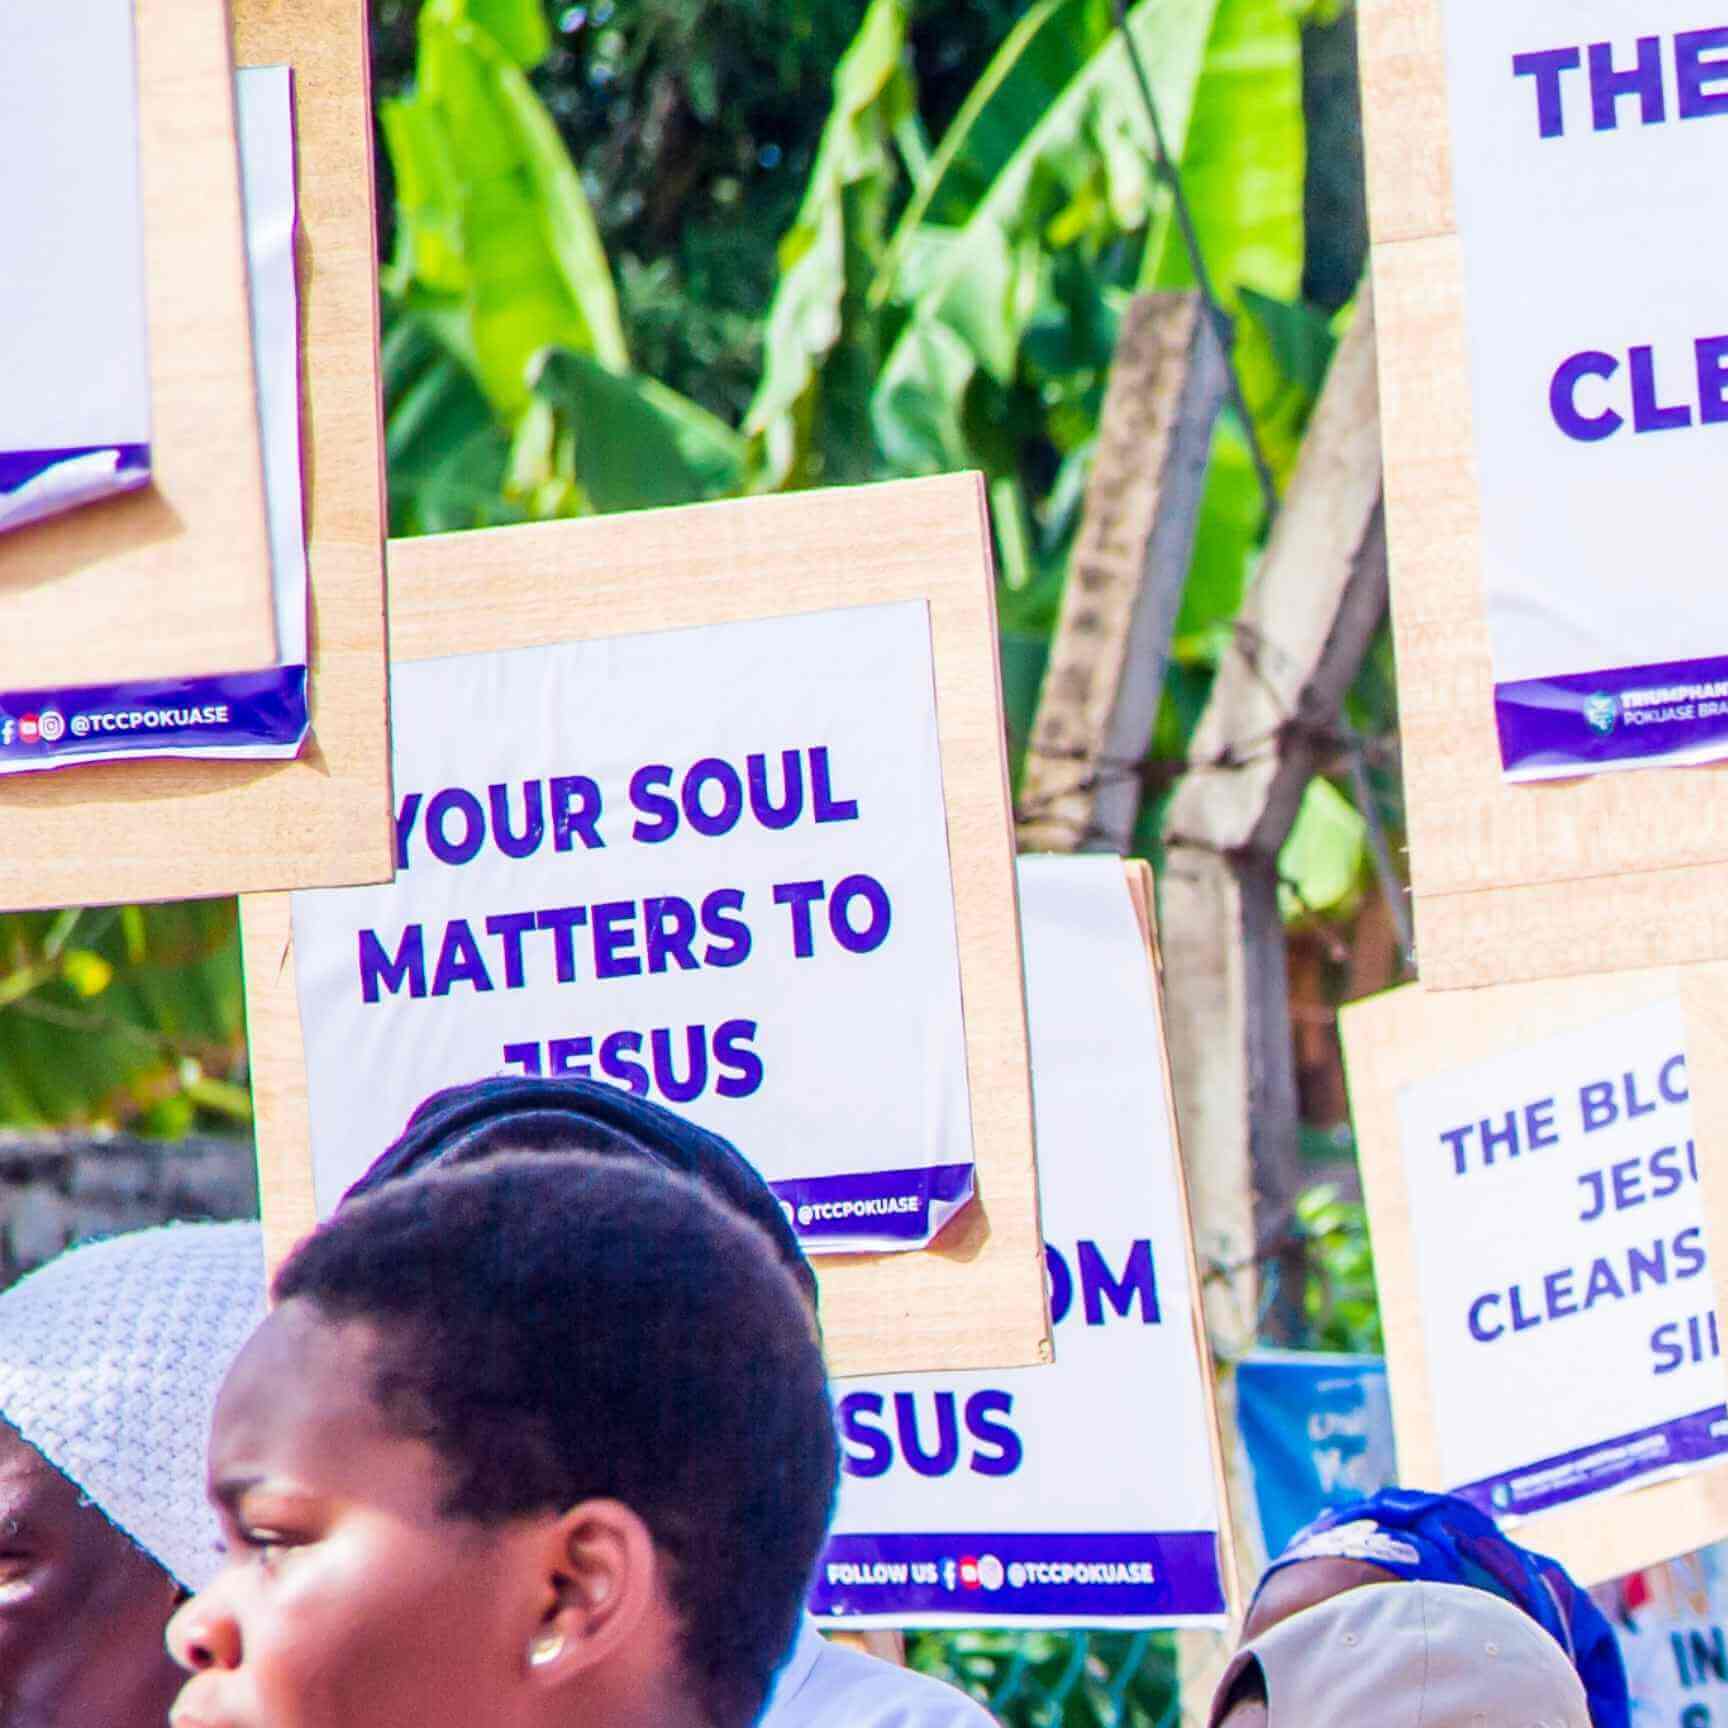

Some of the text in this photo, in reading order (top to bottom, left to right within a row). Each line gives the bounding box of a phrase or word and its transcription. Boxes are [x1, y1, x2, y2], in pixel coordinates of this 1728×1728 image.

[71, 705, 229, 733] @TCCPOKUASE
[1623, 704, 1697, 726] POKUASE
[395, 747, 857, 871] YOUR SOUL
[359, 875, 890, 1003] MATTERS TO
[1442, 1052, 1690, 1172] THE BLO
[797, 1194, 920, 1225] @TCCPOKUASE
[1577, 1138, 1699, 1223] JES
[1467, 1226, 1707, 1343] CLEANS
[1649, 1310, 1720, 1375] SI
[838, 1389, 1024, 1479] SUS
[826, 1561, 1155, 1587] FOLLOW US @TCCPOKUASE
